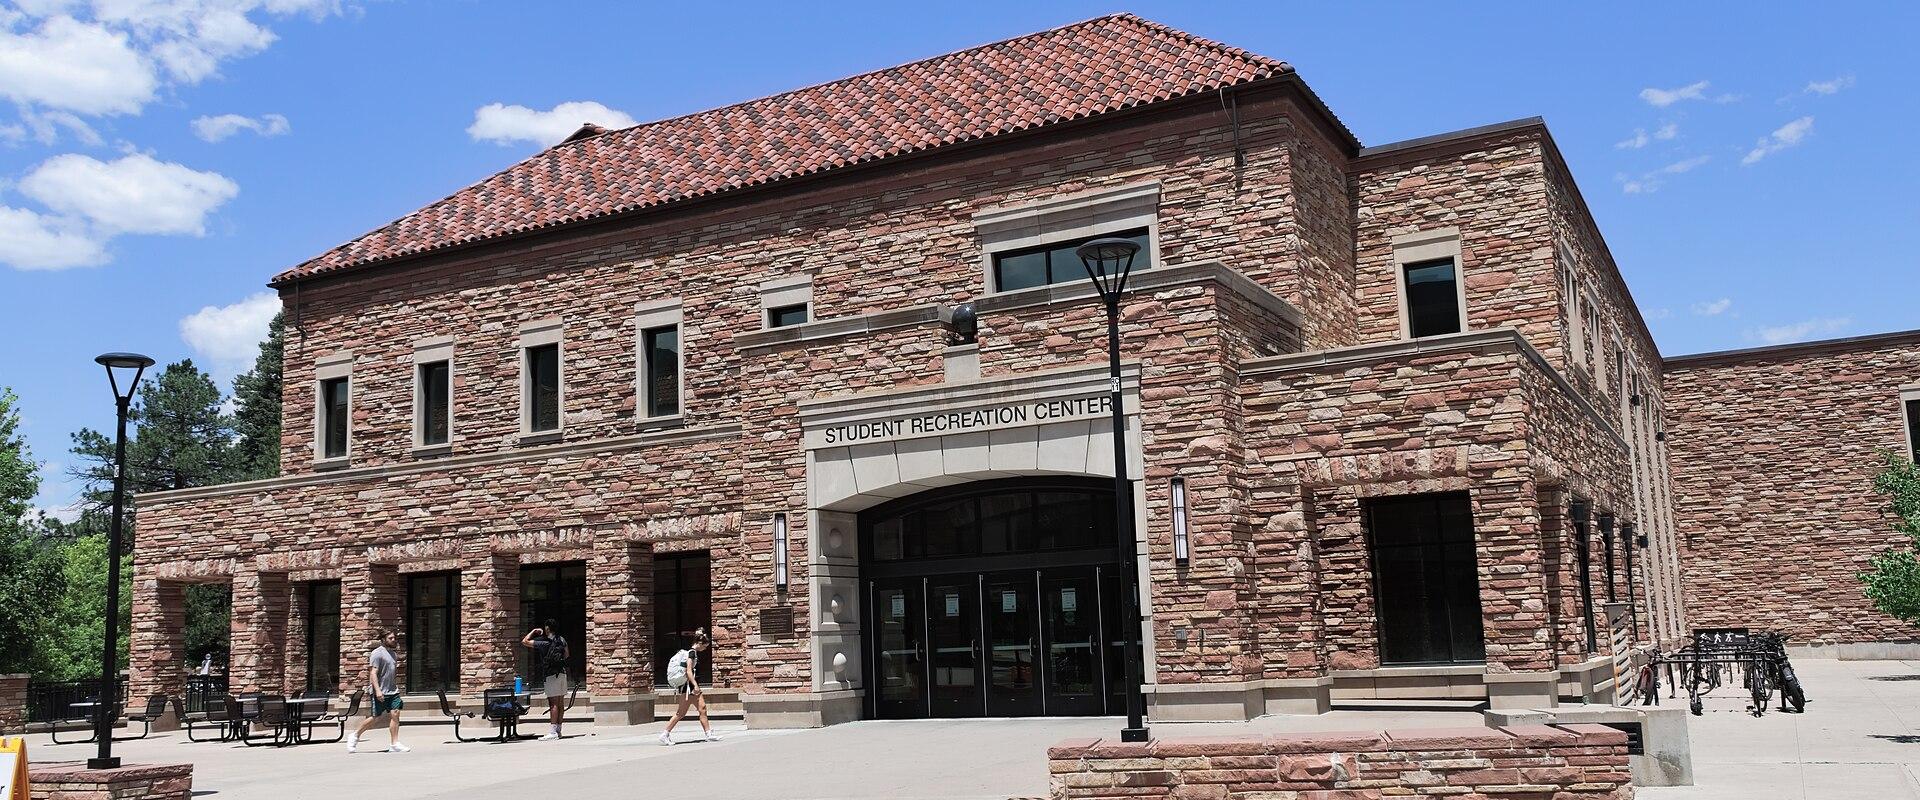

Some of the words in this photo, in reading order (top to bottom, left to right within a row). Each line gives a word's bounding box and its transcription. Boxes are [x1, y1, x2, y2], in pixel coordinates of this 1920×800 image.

[825, 420, 904, 443] STUDENT
[911, 405, 1026, 434] RECREATION
[1034, 396, 1114, 420] CENTER
